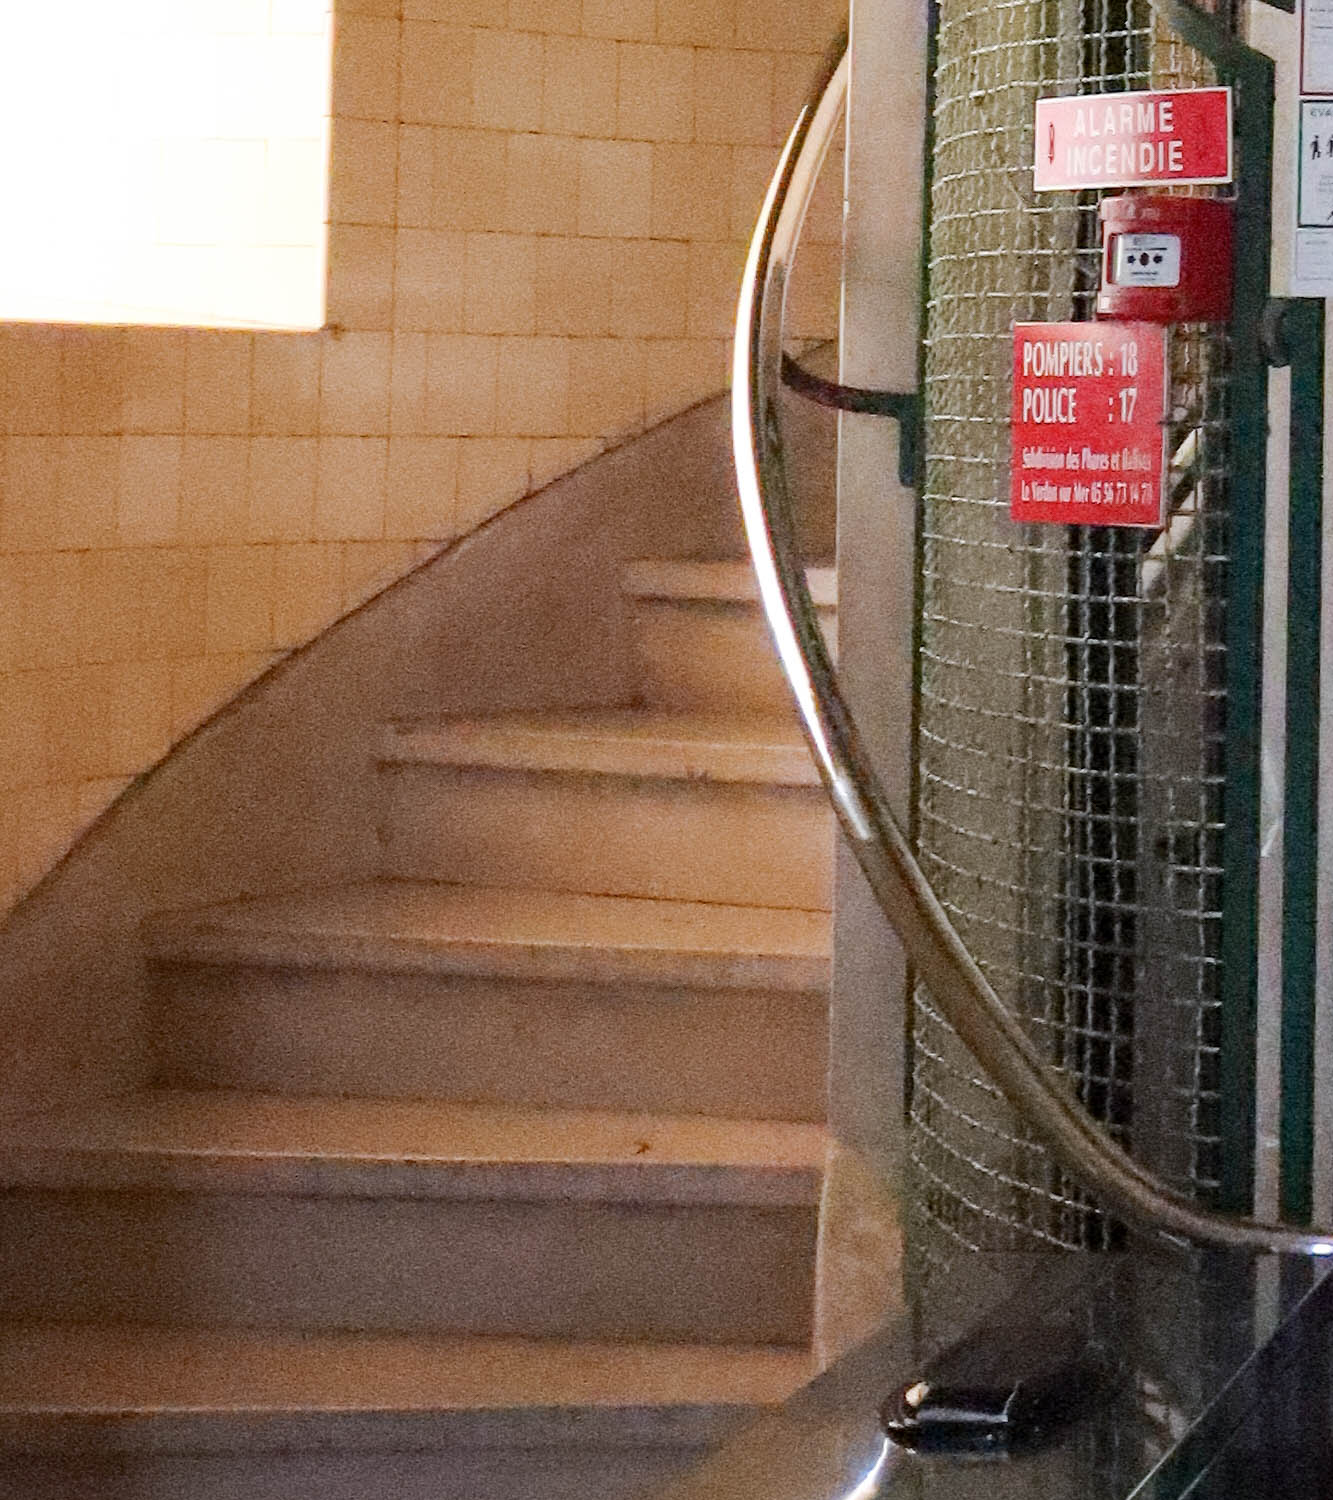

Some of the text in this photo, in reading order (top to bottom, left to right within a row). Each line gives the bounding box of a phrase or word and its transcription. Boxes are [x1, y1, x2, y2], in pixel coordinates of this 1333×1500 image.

[1073, 101, 1174, 137] ALARME
[1066, 140, 1183, 177] INCENDIE
[1023, 341, 1103, 376] POMPIERS
[1121, 342, 1138, 376] 18
[1022, 388, 1077, 424] POLICE
[1119, 388, 1137, 423] 17
